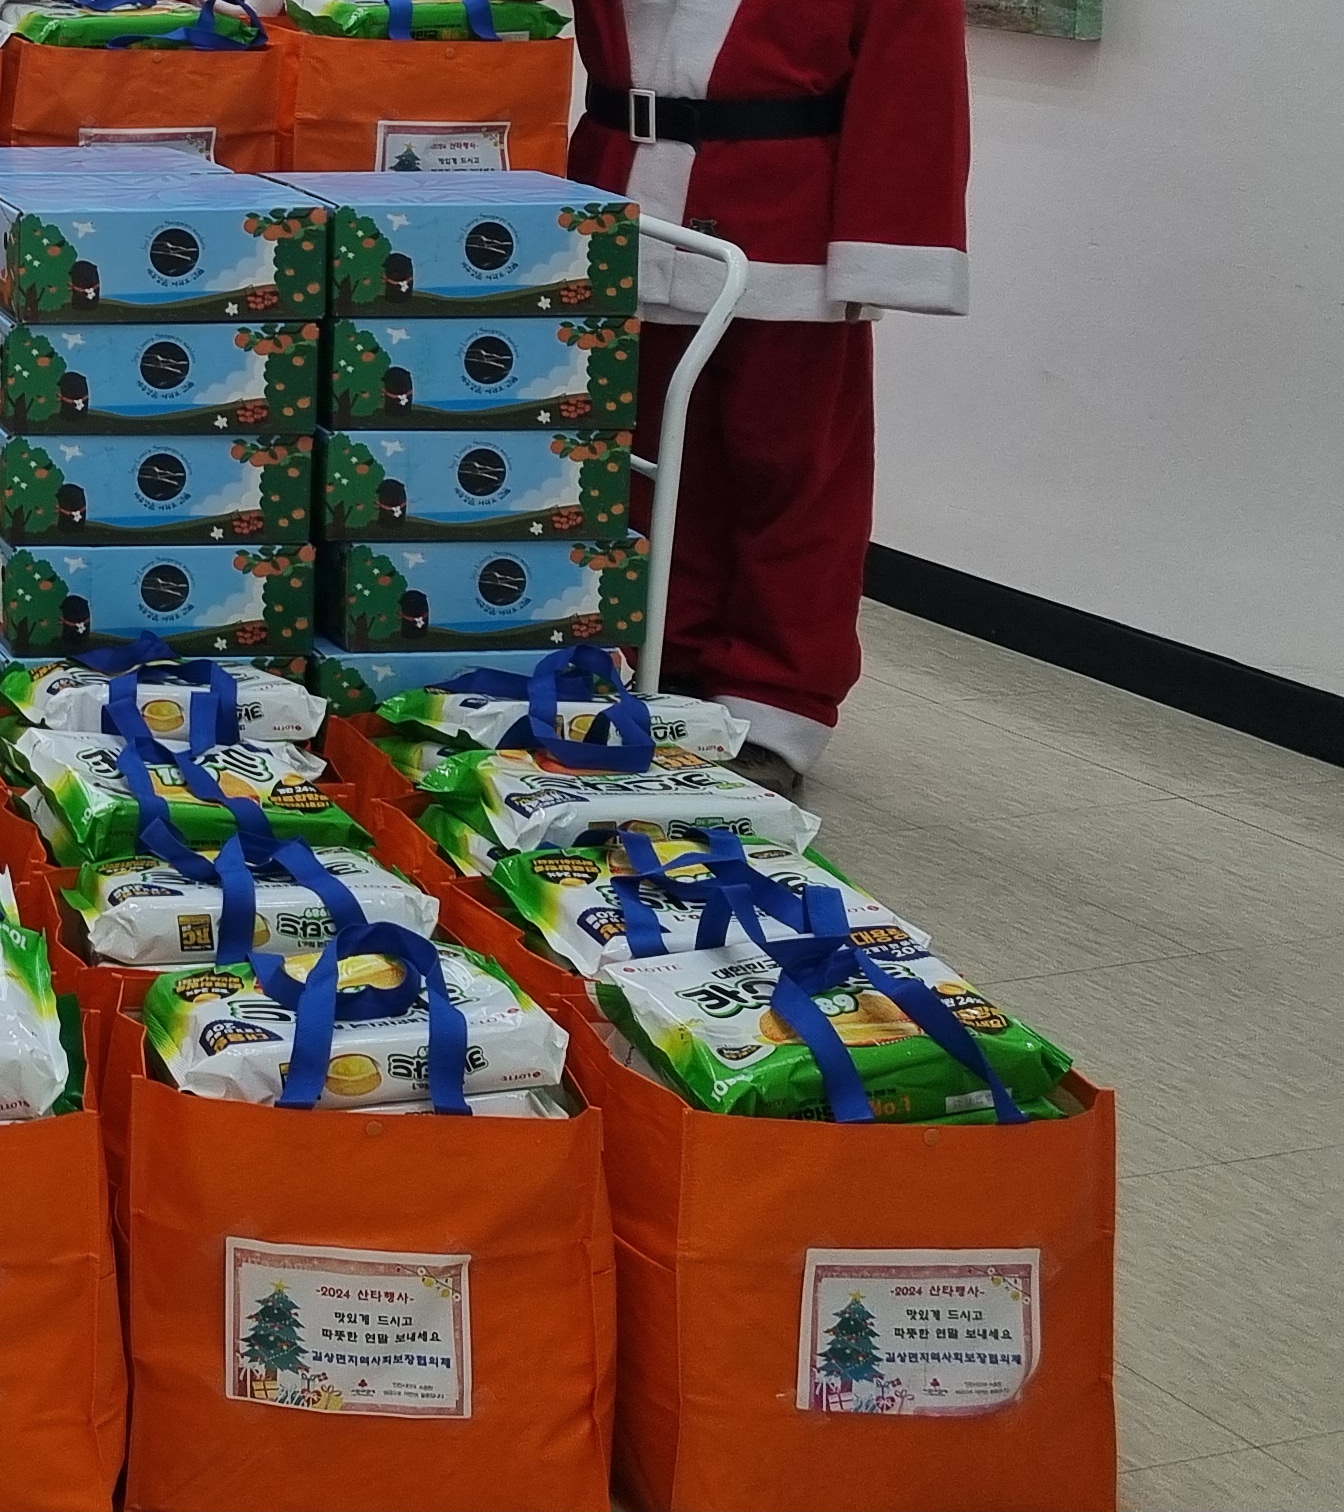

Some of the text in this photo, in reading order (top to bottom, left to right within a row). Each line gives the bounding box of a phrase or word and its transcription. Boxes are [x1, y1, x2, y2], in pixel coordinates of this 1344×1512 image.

[850, 927, 910, 947] 대용량
[637, 963, 681, 975] LOTTE
[315, 1287, 415, 1305] -2024 산타행사-
[890, 1285, 985, 1298] -2024 산타행사-
[334, 1311, 413, 1328] 맛있게 드시고
[906, 1309, 983, 1321] 맛있게 드시고
[321, 1328, 442, 1344] 따뜻한 연말 보내세요
[893, 1326, 1013, 1340] 따뜻한 연말 보내세요
